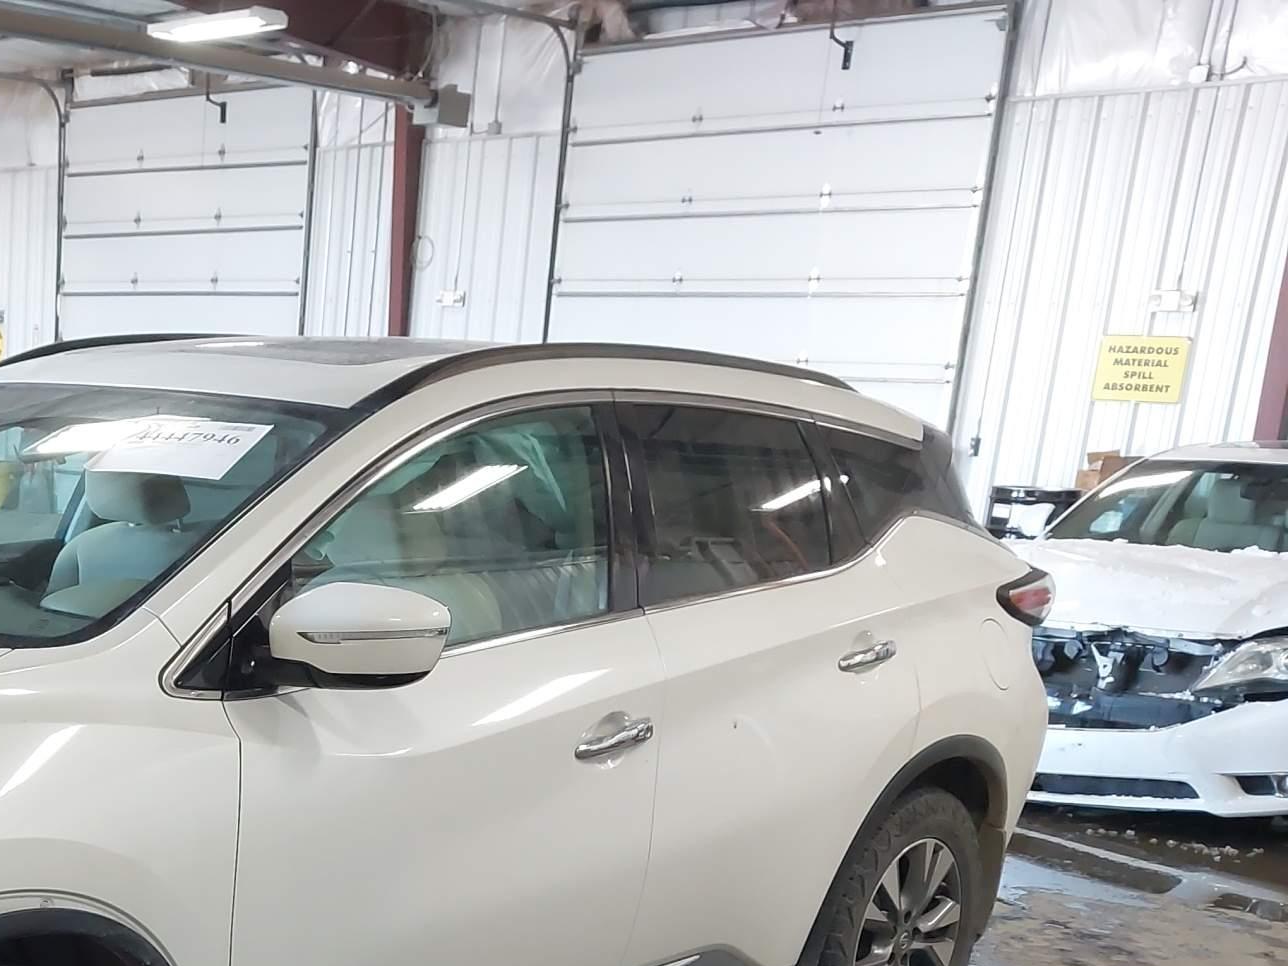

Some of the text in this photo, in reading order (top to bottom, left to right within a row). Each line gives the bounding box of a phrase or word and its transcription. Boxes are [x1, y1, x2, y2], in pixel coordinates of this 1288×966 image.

[1108, 345, 1180, 355] HAZARDOUS
[1112, 358, 1169, 368] MATERIAL
[1123, 370, 1154, 379] SPILL
[1103, 382, 1171, 393] ABSORBENT
